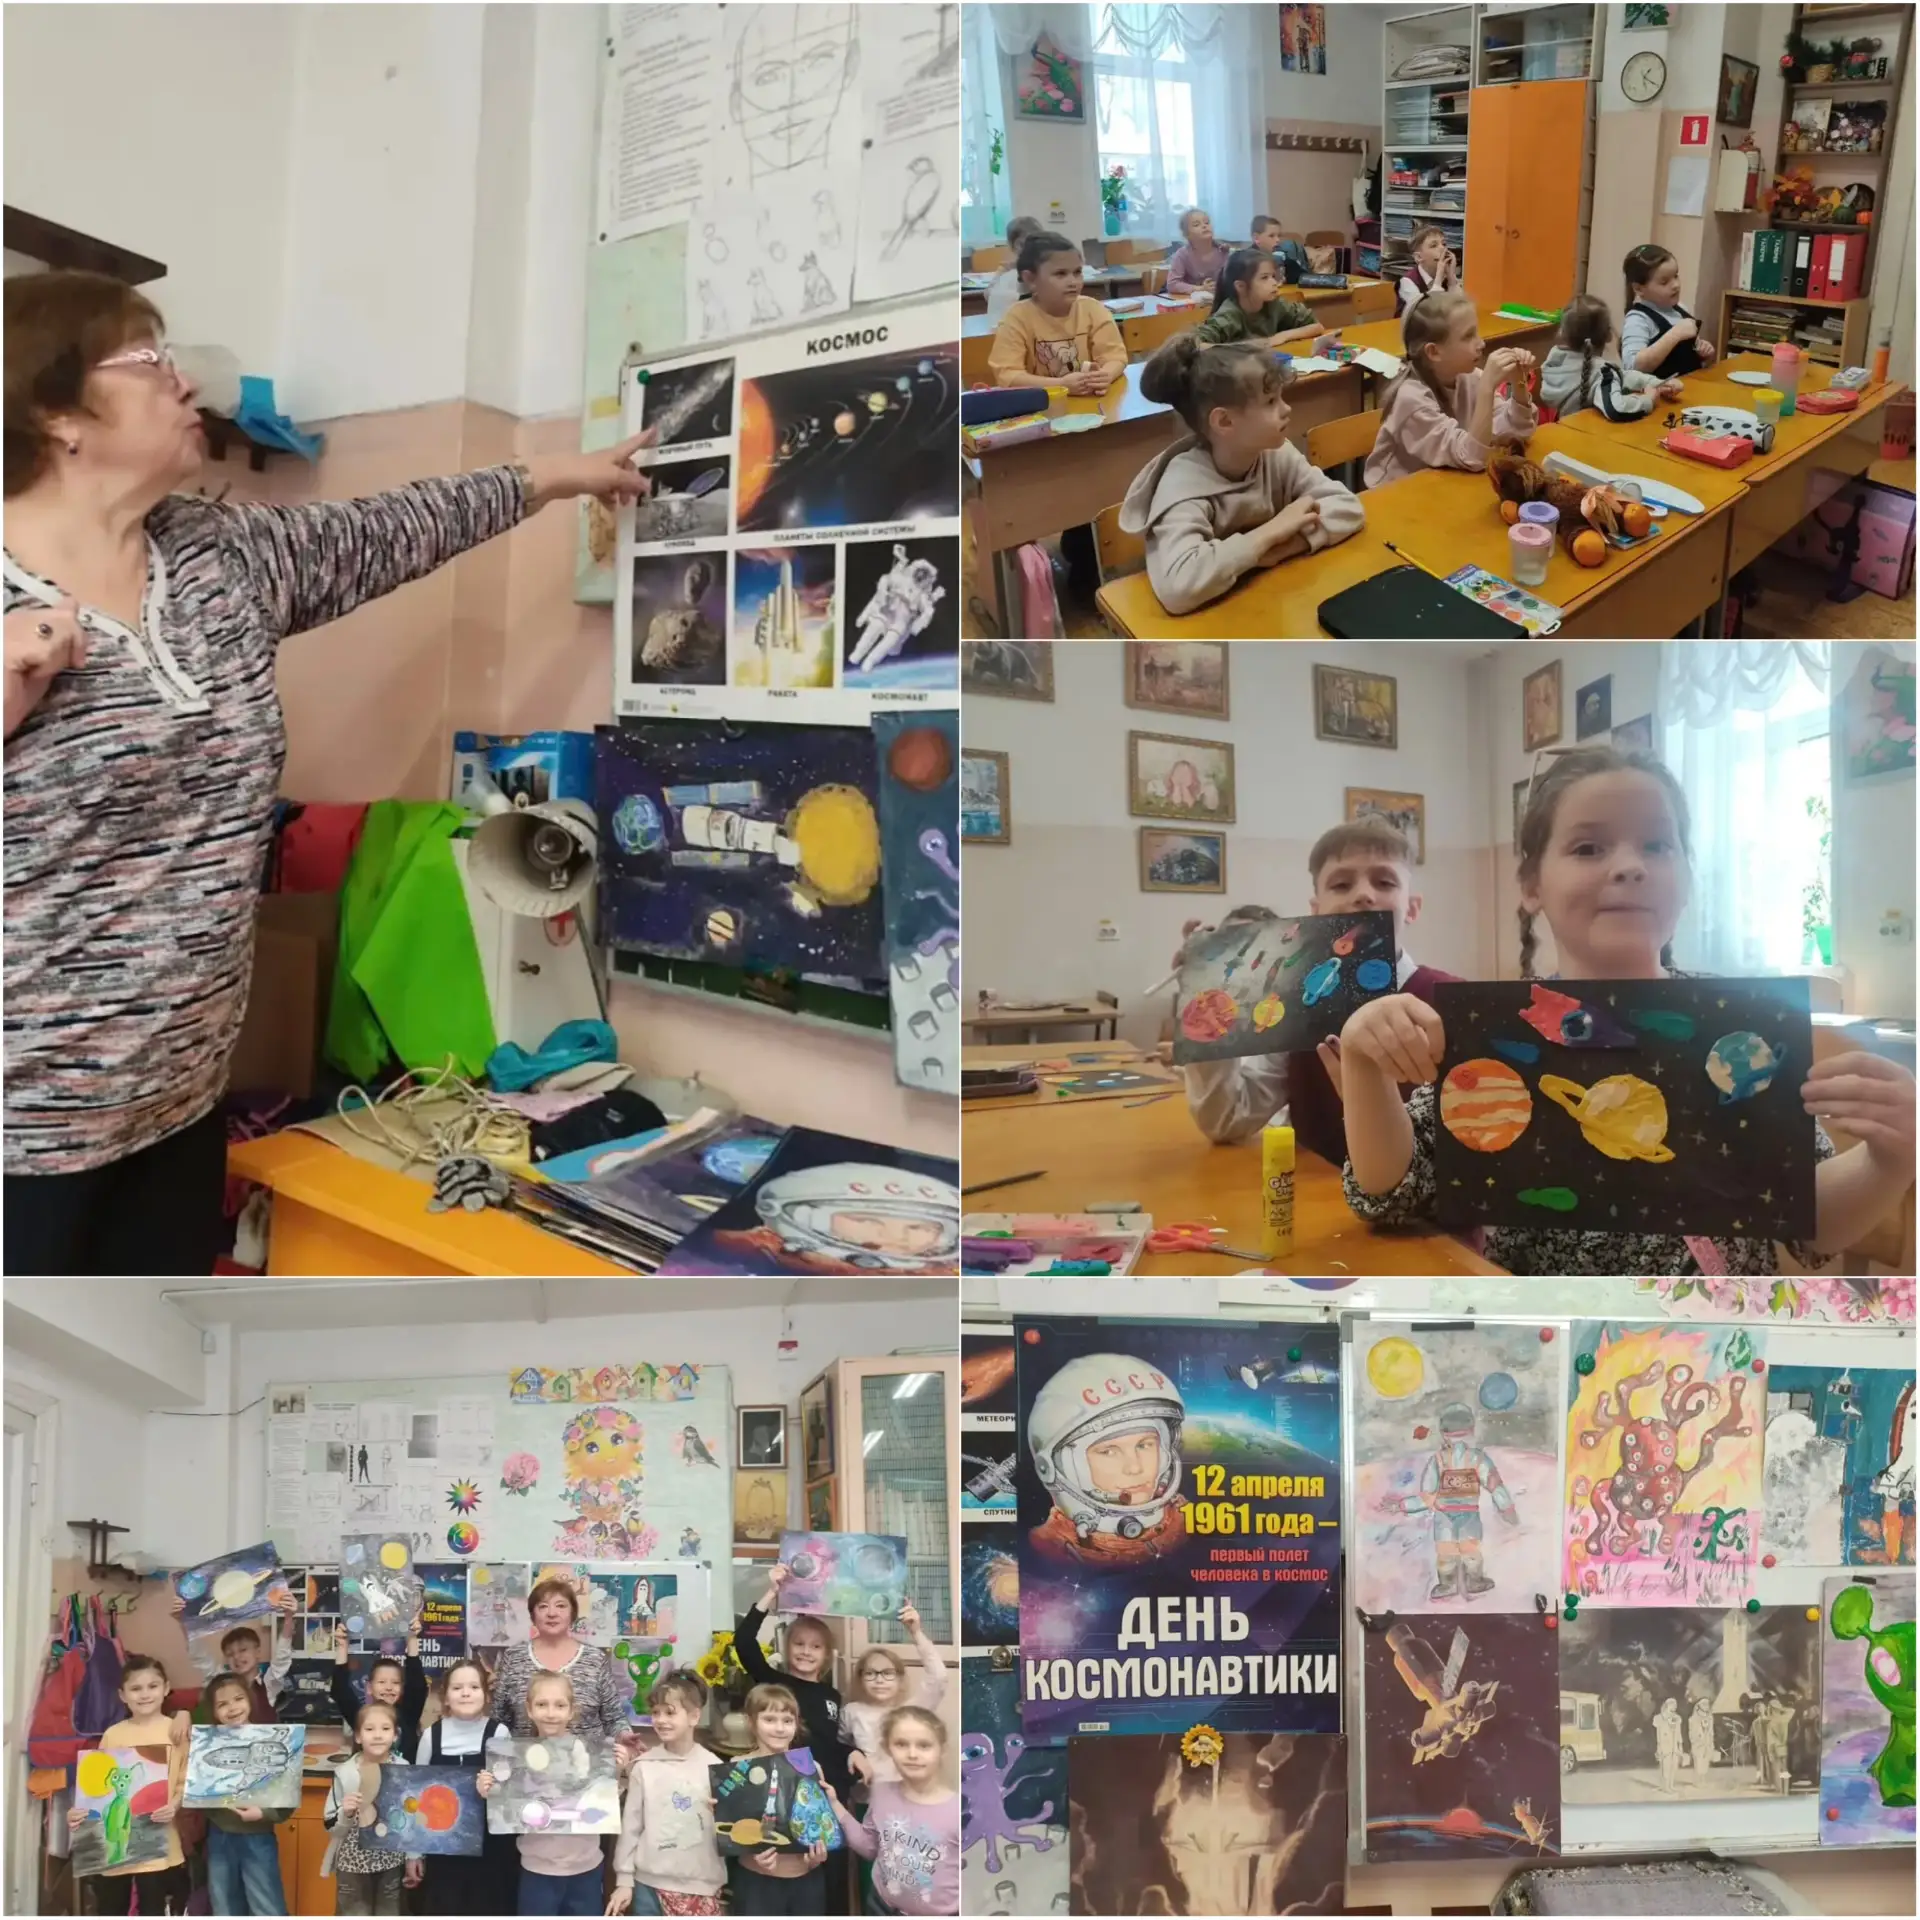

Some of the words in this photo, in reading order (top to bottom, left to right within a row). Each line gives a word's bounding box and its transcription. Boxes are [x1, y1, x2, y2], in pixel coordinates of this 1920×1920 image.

[806, 326, 889, 356] КОСМОС
[871, 692, 929, 702] КОСМОНАВТ
[1082, 1372, 1165, 1406] СССР
[1191, 1464, 1226, 1497] 12
[1230, 1475, 1325, 1500] апреля
[1179, 1501, 1251, 1535] 1961
[1255, 1512, 1315, 1538] года
[1210, 1546, 1265, 1563] первый
[1269, 1548, 1310, 1563] полет
[1190, 1568, 1259, 1583] человека
[1262, 1569, 1271, 1582] в
[1274, 1568, 1329, 1583] космос
[426, 1602, 436, 1611] 12
[1117, 1595, 1250, 1651] ДЕНЬ
[1025, 1654, 1338, 1701] КОСМОНАВТИКИ
[879, 1829, 889, 1842] E
[894, 1830, 941, 1861] KIND
